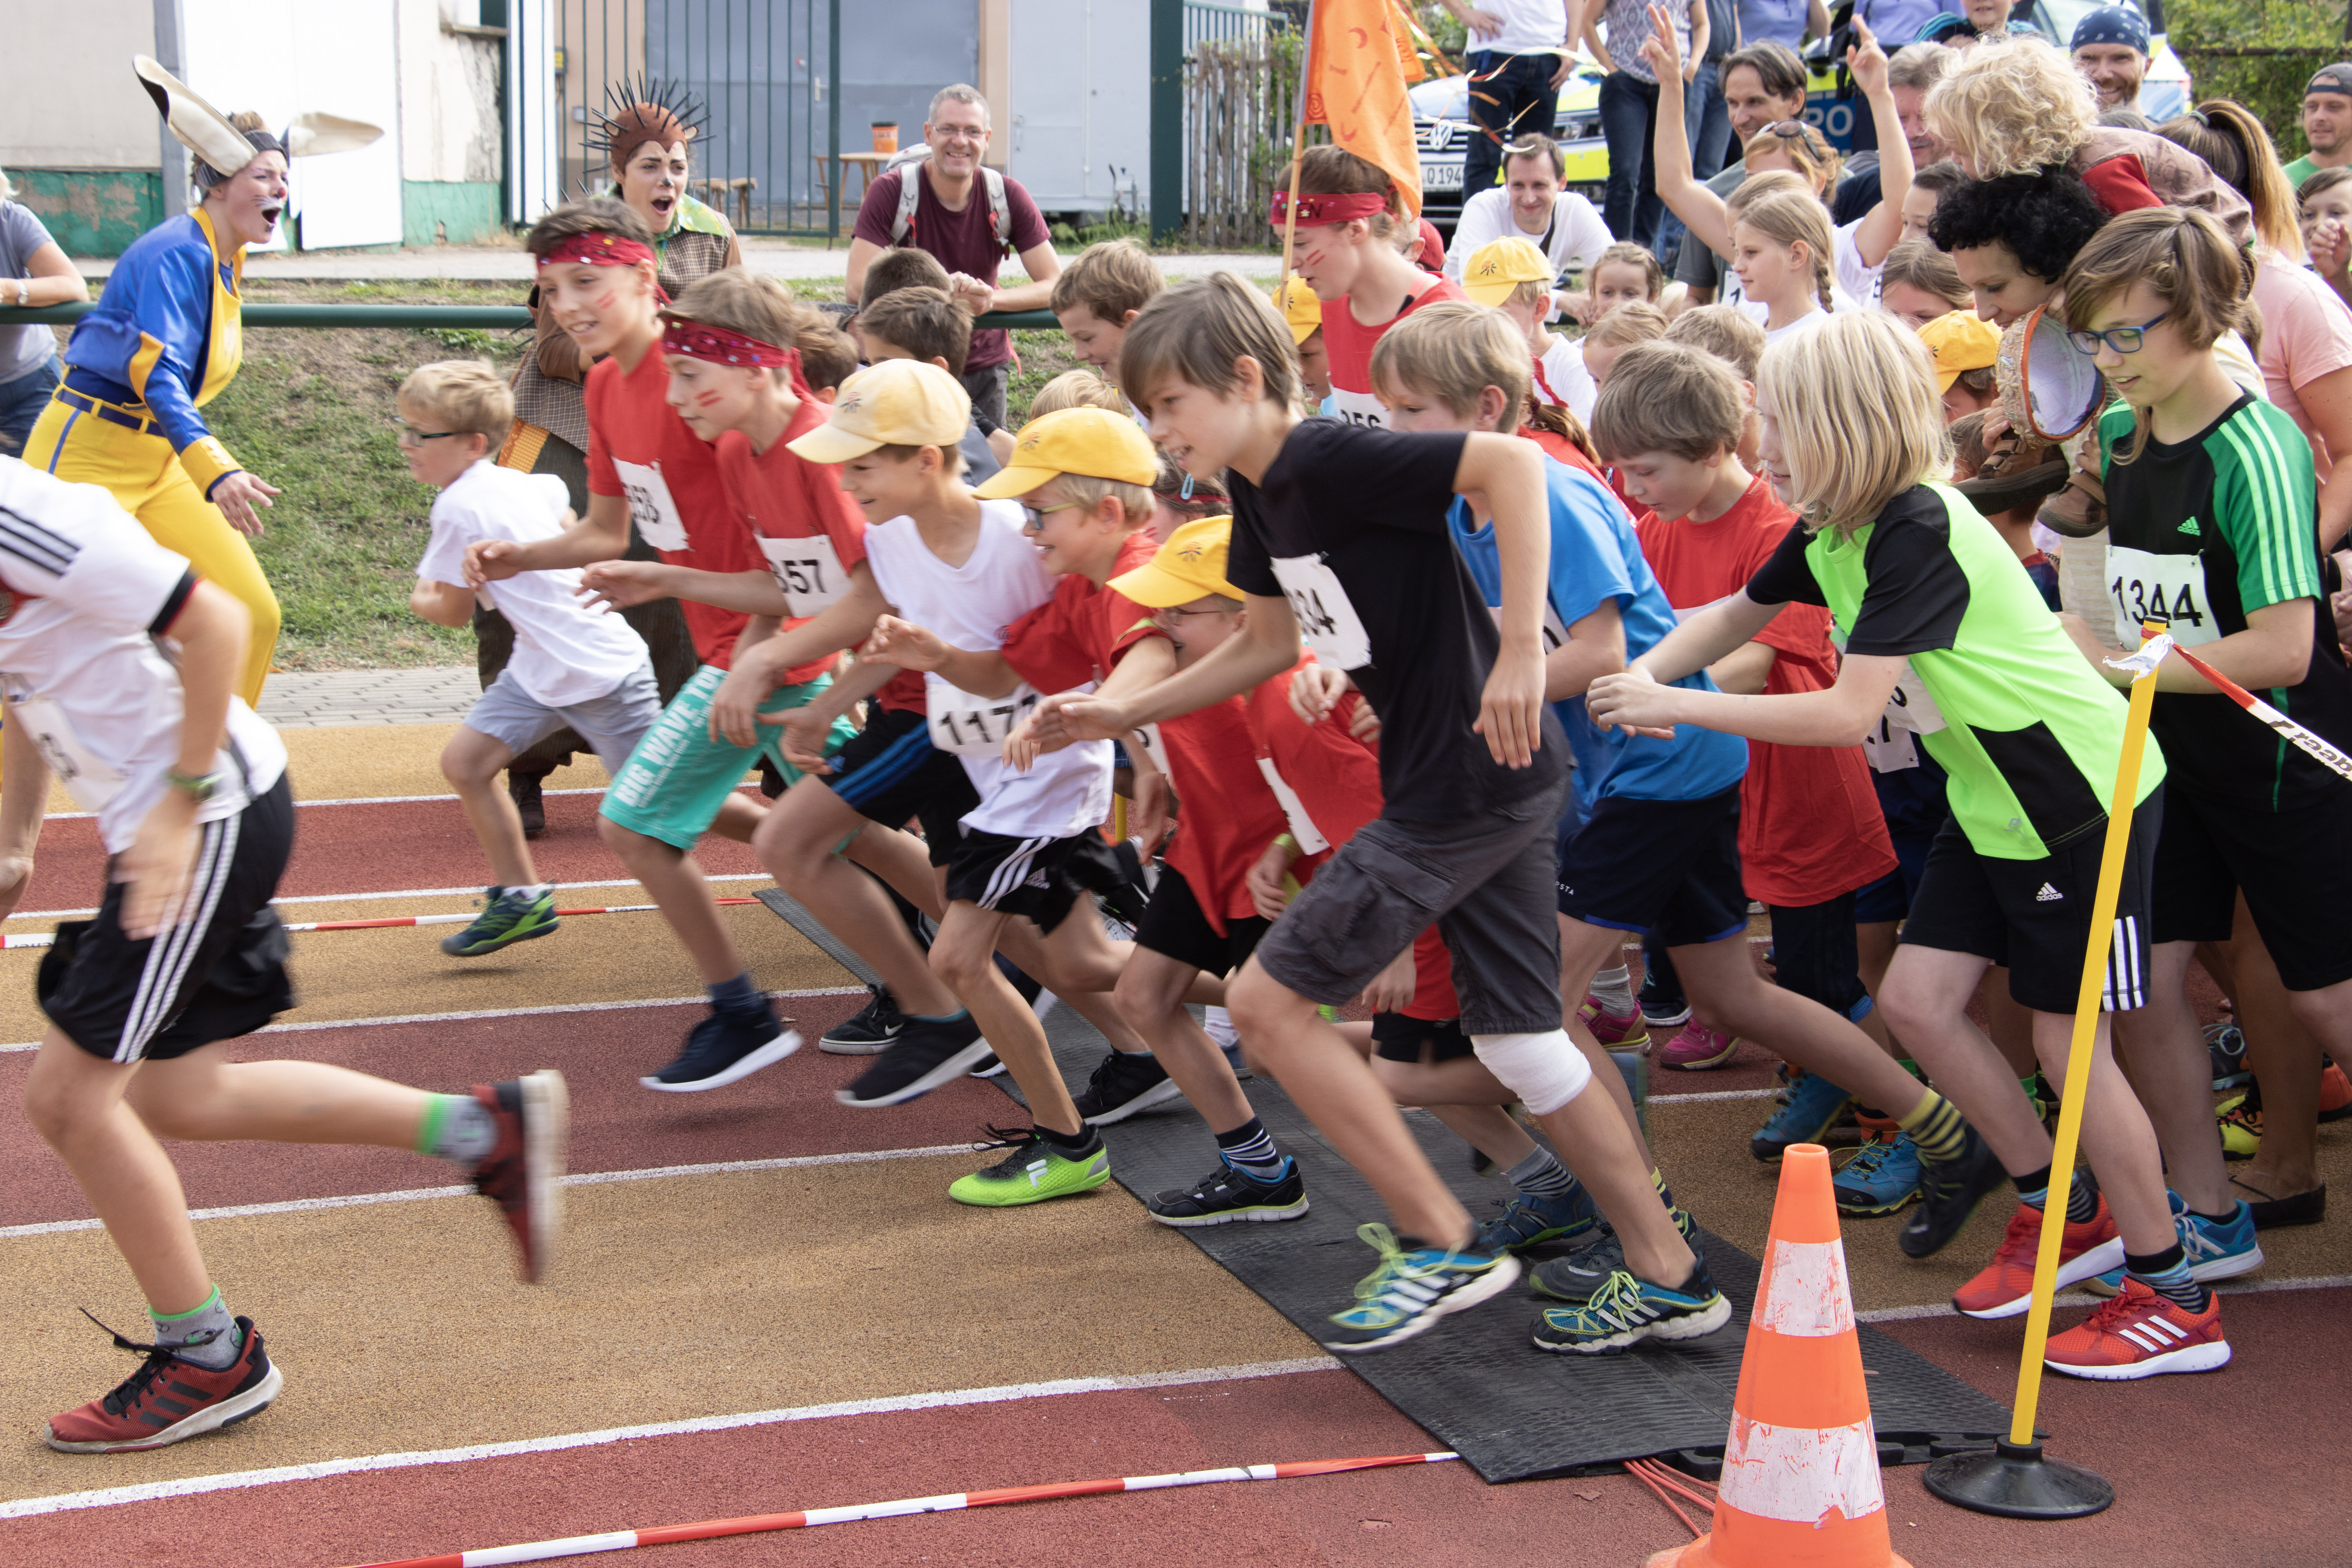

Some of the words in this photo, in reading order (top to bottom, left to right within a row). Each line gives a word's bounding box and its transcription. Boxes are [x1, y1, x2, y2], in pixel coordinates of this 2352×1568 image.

[2112, 576, 2204, 629] 1344
[613, 764, 655, 807] BIG
[639, 699, 699, 765] WAVE
[2036, 893, 2063, 901] adidas
